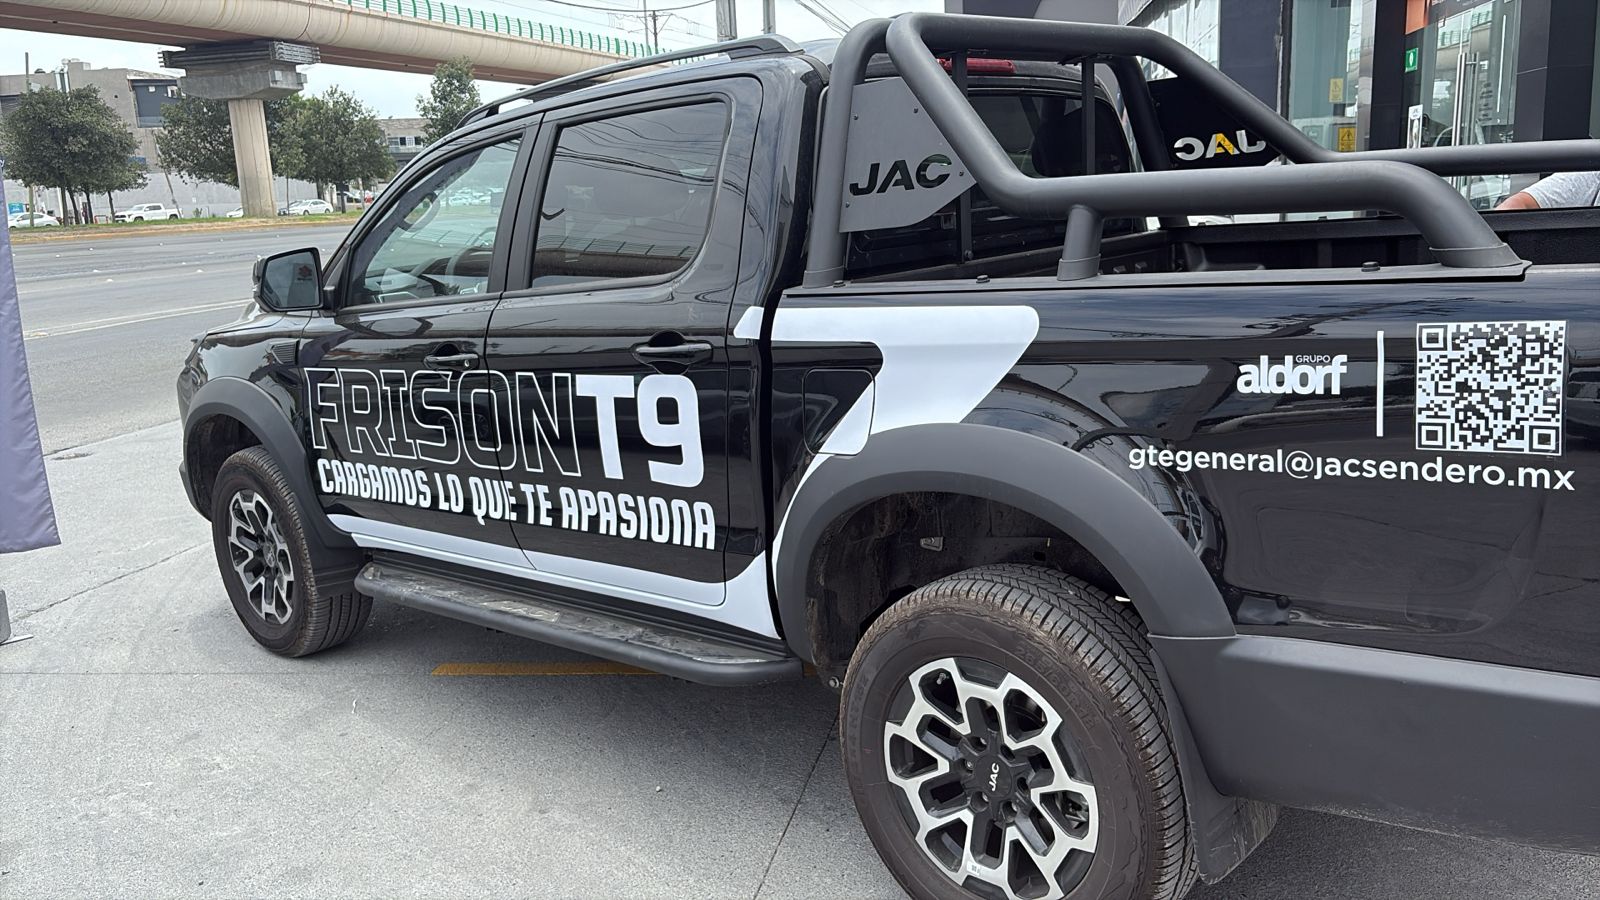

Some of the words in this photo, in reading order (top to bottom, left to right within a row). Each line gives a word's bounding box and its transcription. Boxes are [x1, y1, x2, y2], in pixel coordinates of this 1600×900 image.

[850, 153, 952, 196] JAC
[1236, 354, 1348, 396] aldorf
[1295, 353, 1332, 364] GRUPO
[1127, 444, 1576, 492] gtegeneral@jacsendero.mx
[317, 457, 432, 508] CARGAMOS
[434, 472, 464, 514] LO
[469, 475, 518, 526] QUE
[519, 482, 553, 527] TE
[561, 486, 716, 551] APASIONA
[988, 762, 1000, 792] JAC
